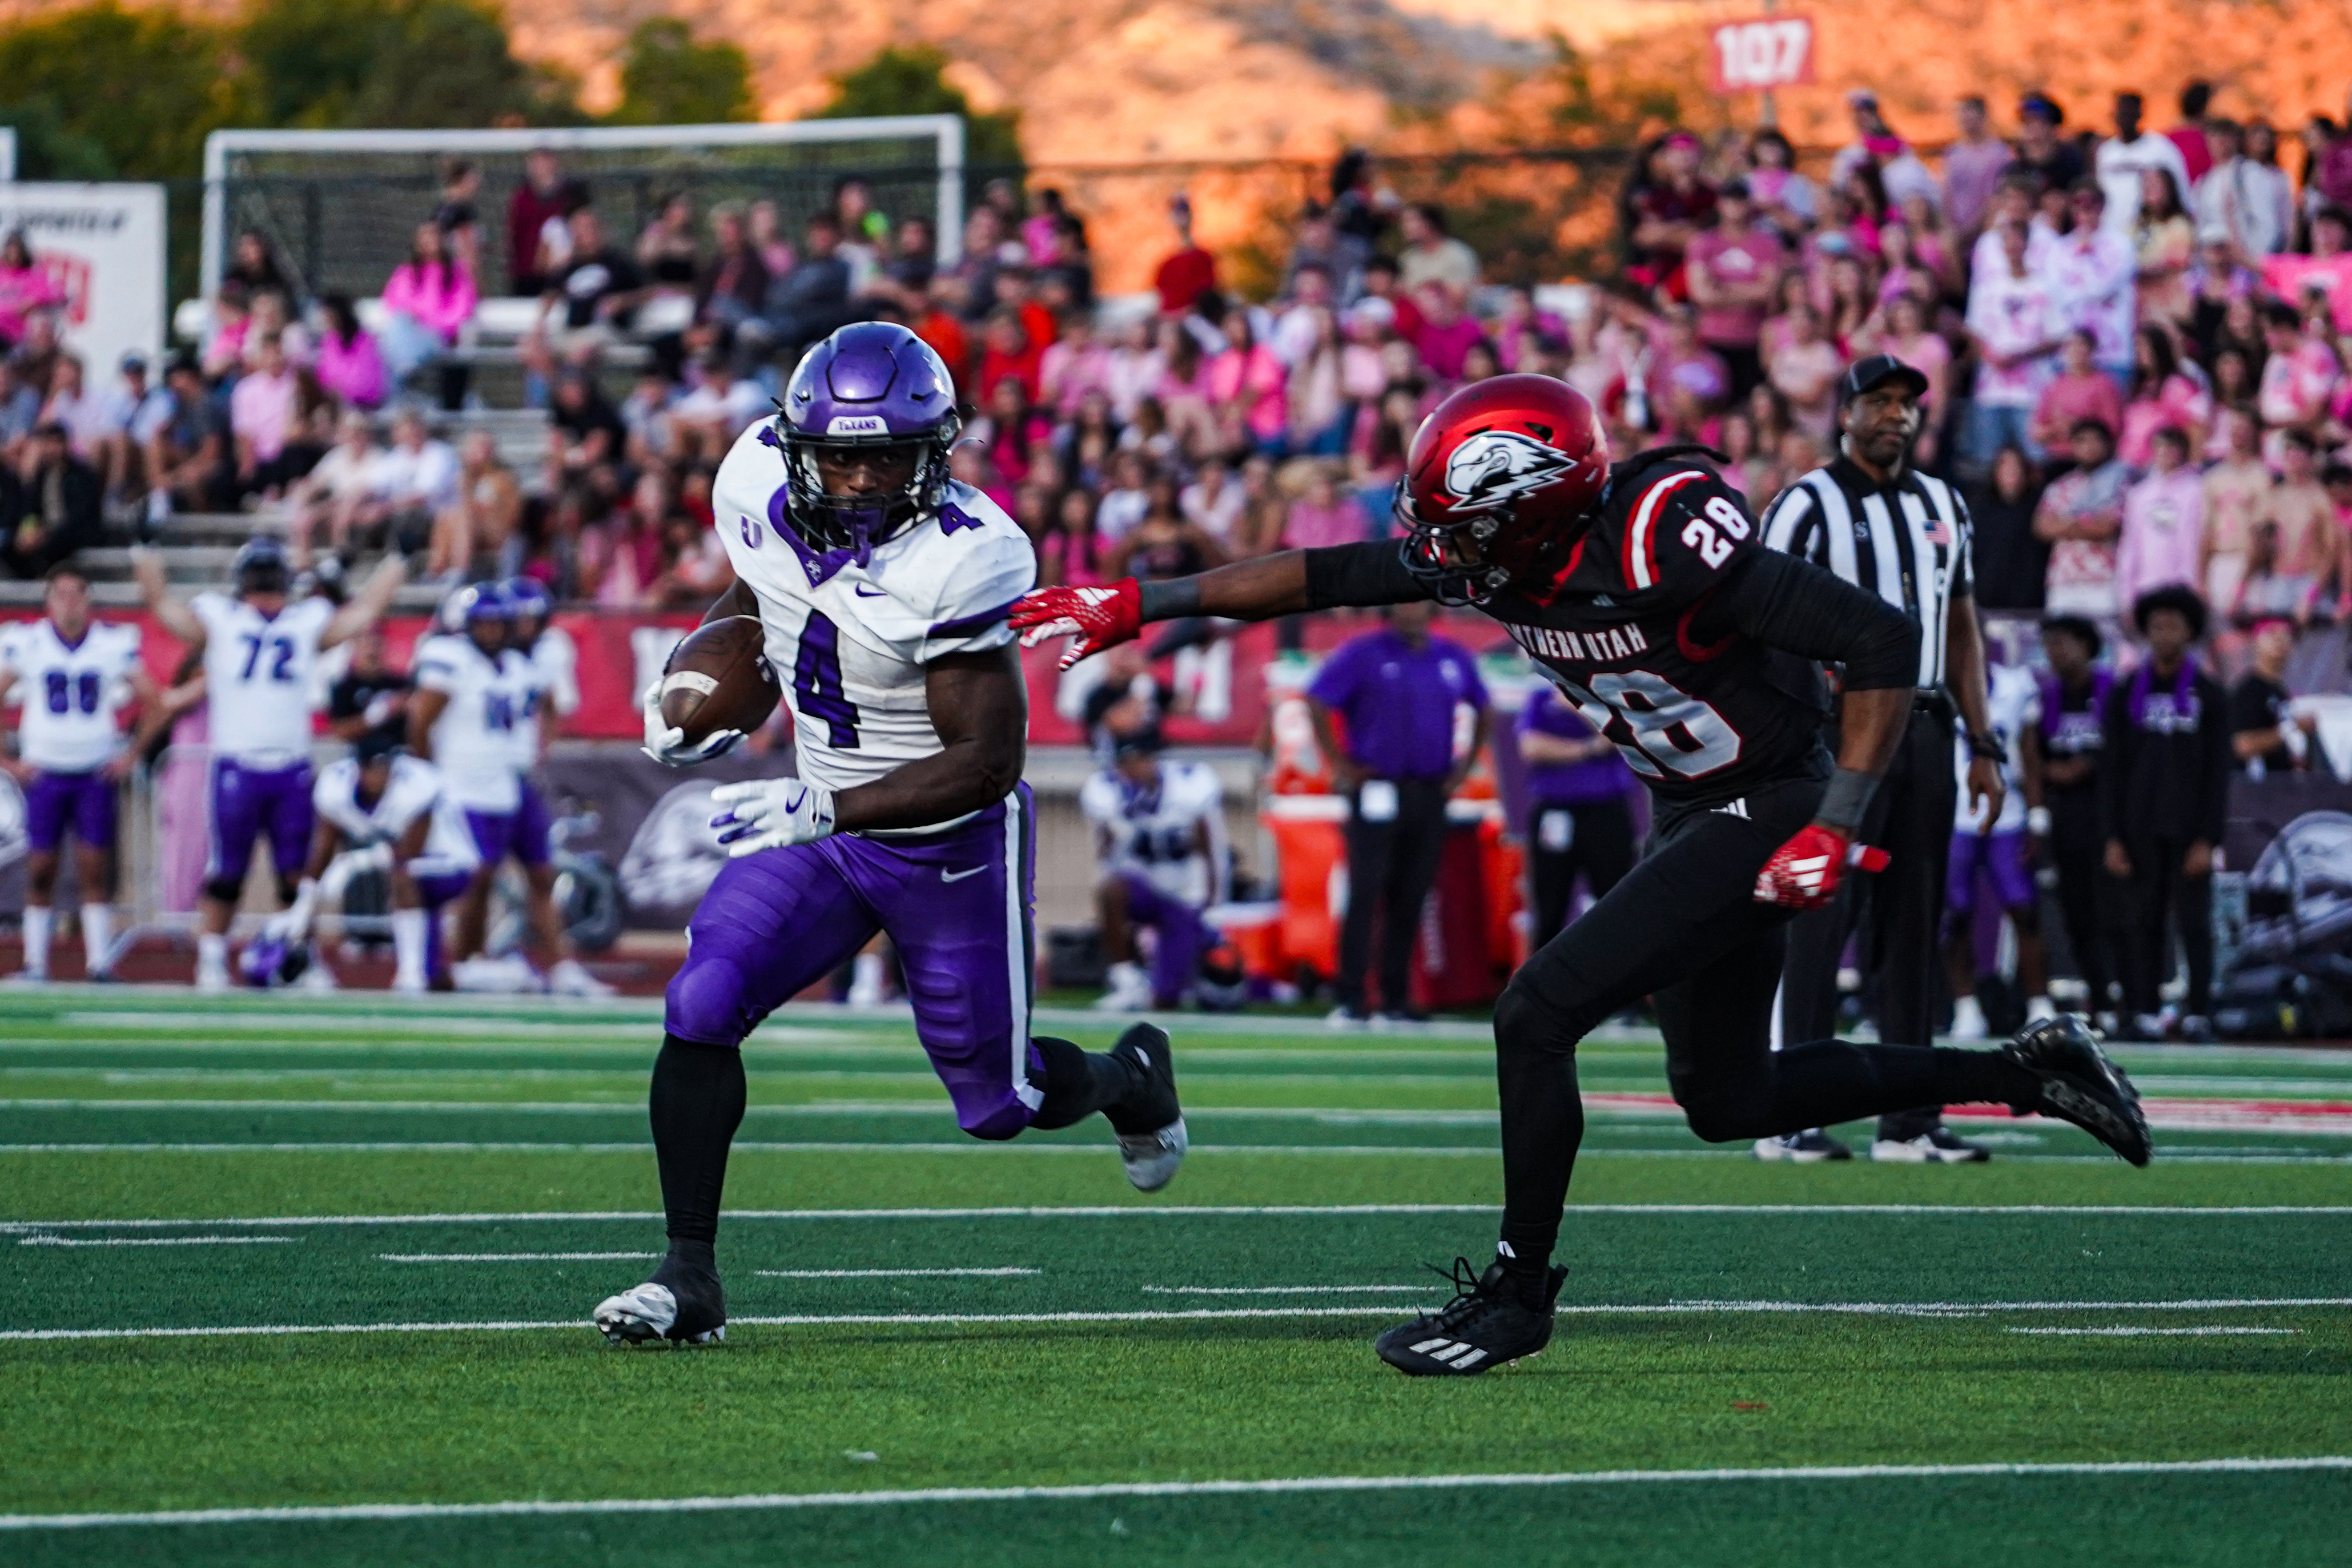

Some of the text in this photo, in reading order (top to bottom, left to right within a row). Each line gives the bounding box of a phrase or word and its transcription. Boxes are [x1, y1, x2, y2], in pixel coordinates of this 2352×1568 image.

[1715, 19, 1811, 87] 107
[839, 420, 877, 431] TEXANS
[936, 502, 985, 537] 4
[1681, 496, 1751, 570] 28
[240, 634, 295, 681] 72
[1582, 622, 1649, 661] UTAH
[794, 608, 861, 748] 4
